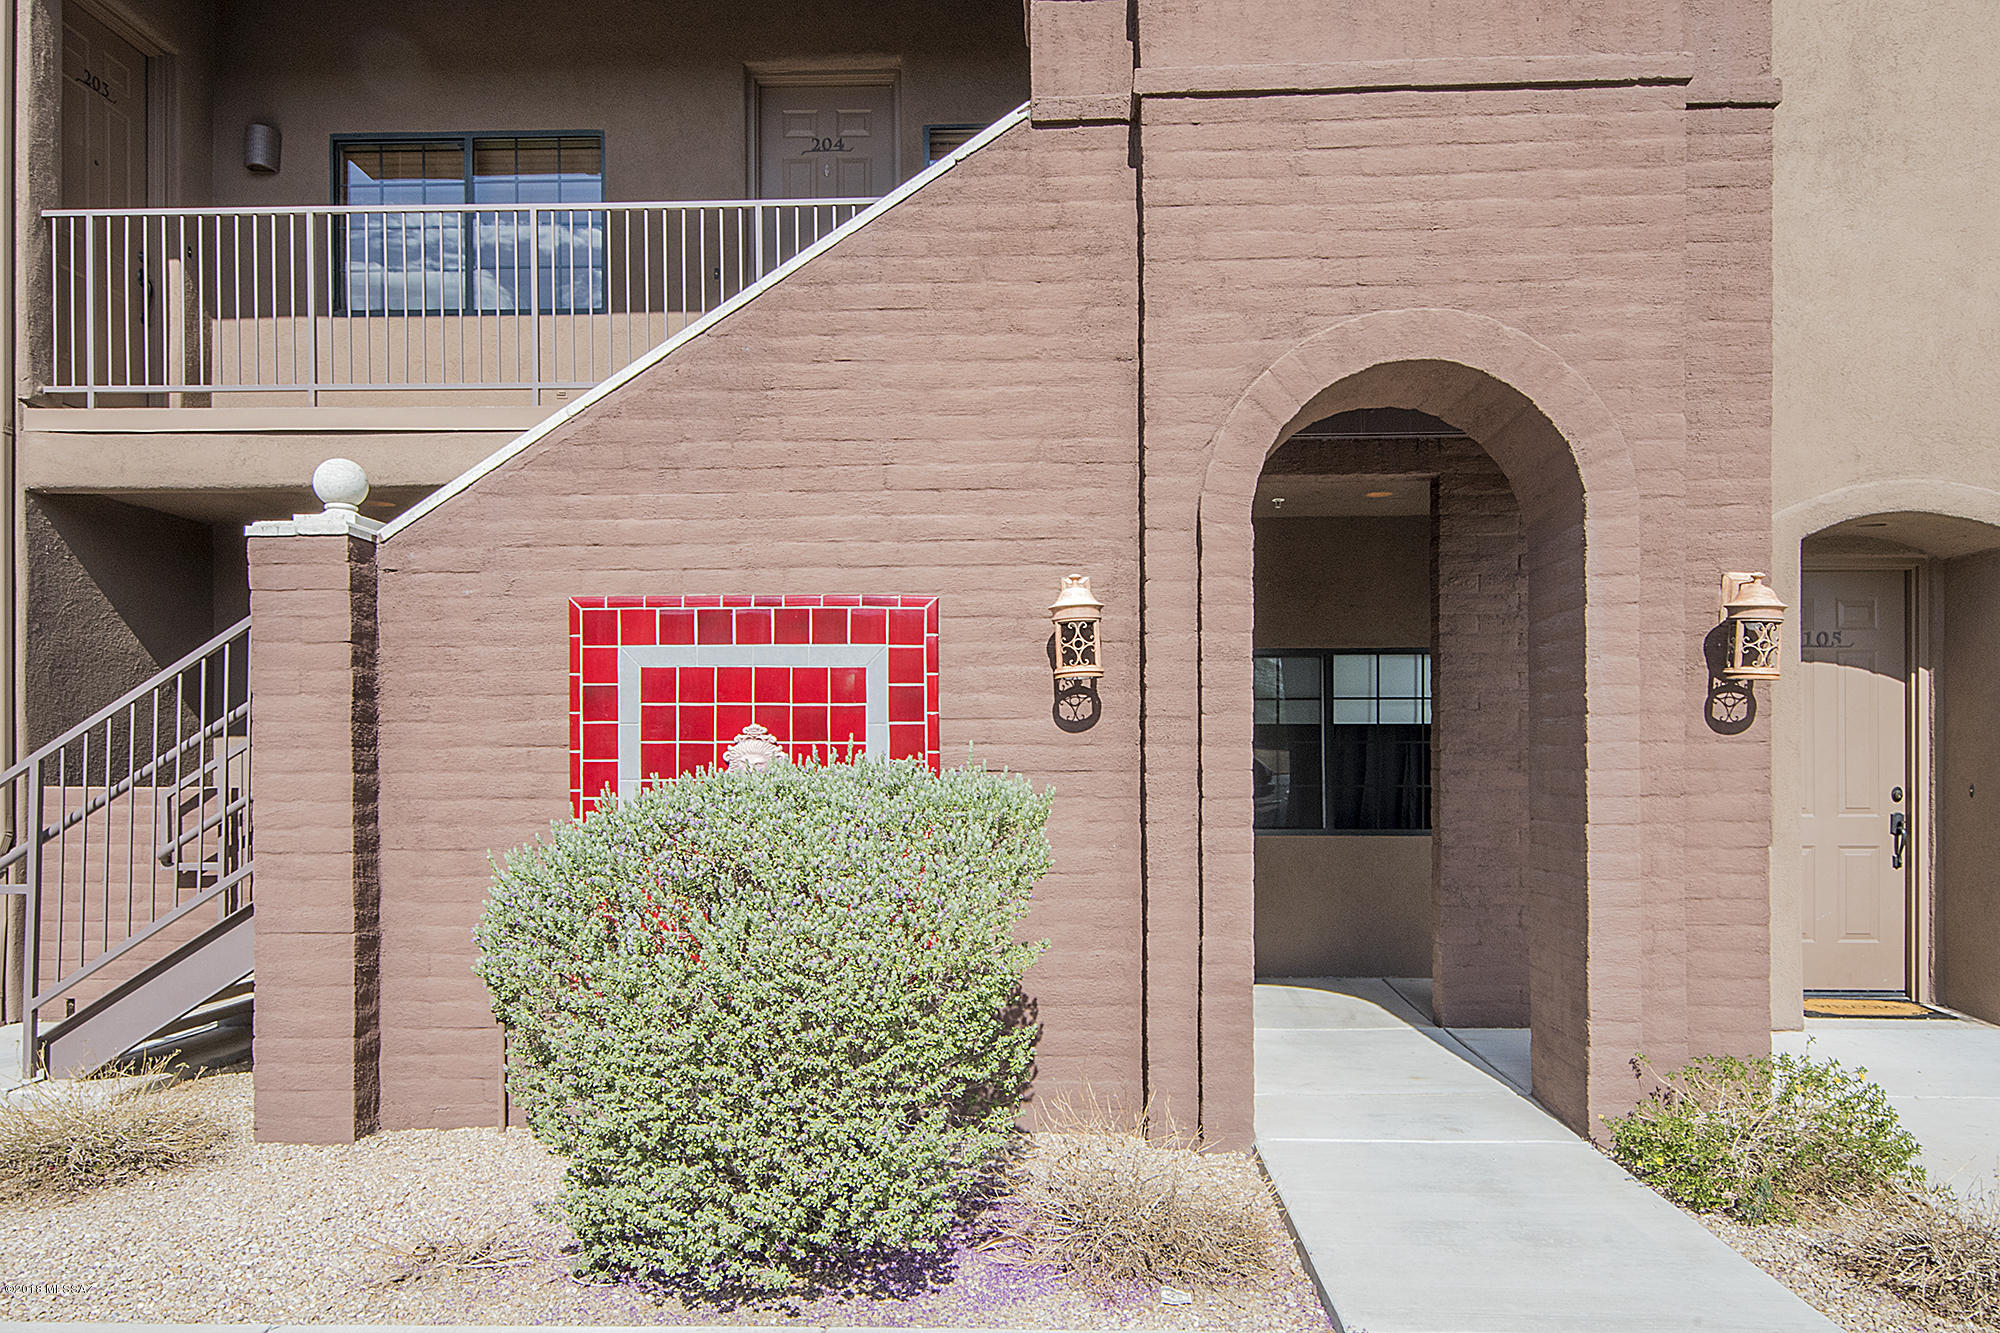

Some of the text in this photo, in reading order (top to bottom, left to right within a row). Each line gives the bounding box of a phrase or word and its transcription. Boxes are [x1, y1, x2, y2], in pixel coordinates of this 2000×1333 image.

[83, 68, 110, 98] 203
[811, 136, 845, 152] 204
[1803, 631, 1842, 648] 105
